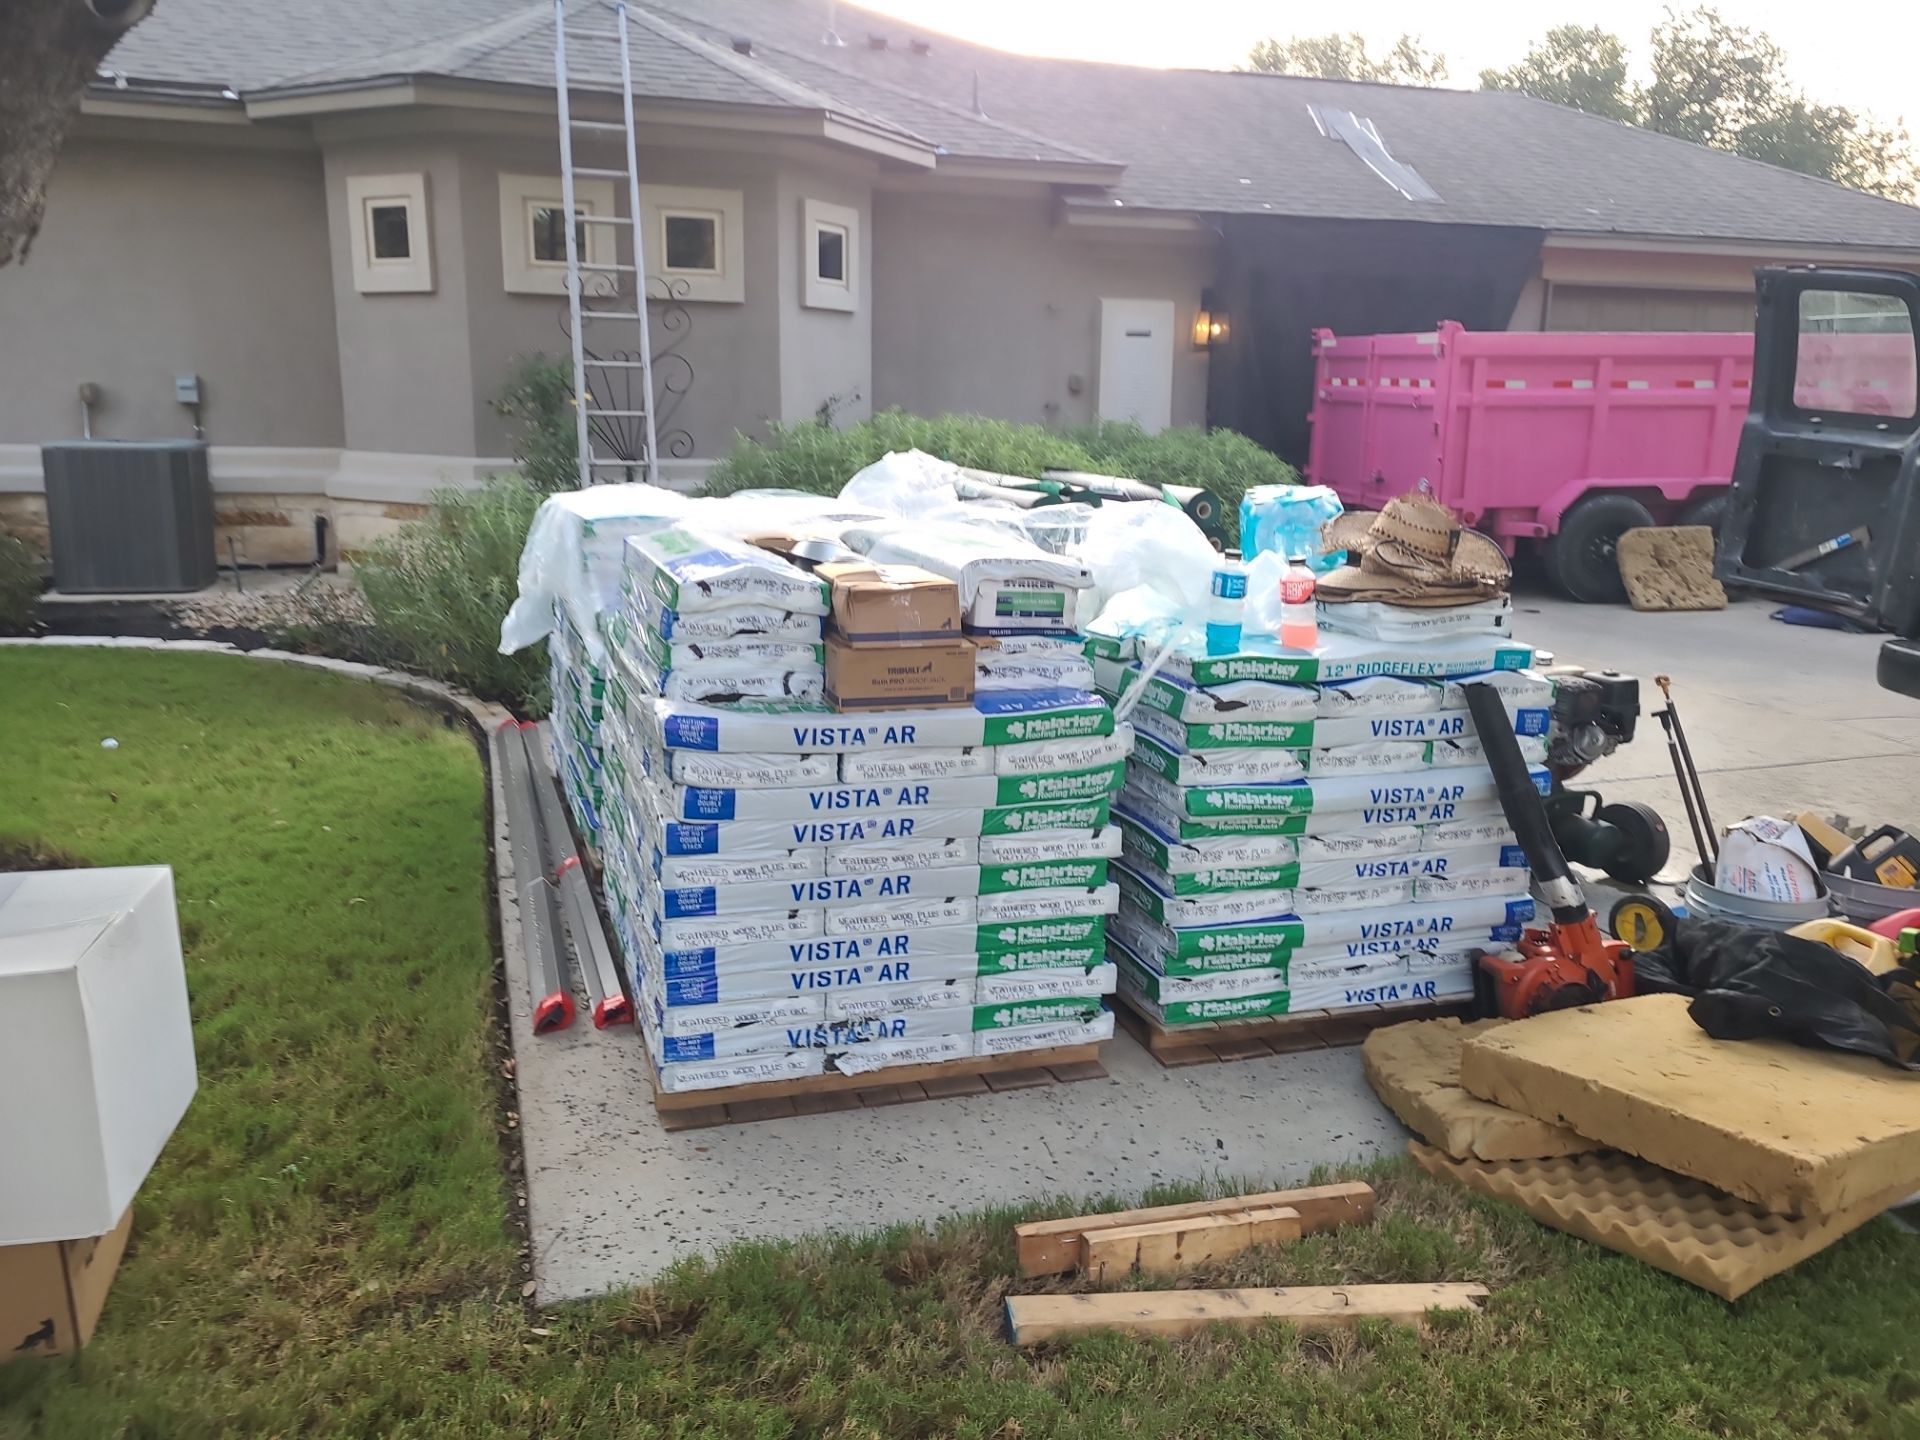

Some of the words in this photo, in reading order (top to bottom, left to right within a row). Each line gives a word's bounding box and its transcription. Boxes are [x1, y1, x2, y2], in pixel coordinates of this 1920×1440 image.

[1229, 661, 1299, 676] Malarkey
[1325, 664, 1352, 678] 12"
[1026, 714, 1103, 730] Malarkey
[1439, 717, 1465, 735] AR
[884, 726, 916, 744] AR
[1226, 723, 1294, 738] Malarkey
[1038, 770, 1114, 790] Malarkey
[897, 786, 930, 805] AR
[1224, 791, 1293, 806] Malarkey
[1438, 786, 1465, 802] AR
[882, 819, 914, 837] AR
[1020, 865, 1097, 879] Malarkey
[1423, 858, 1448, 873] AR
[879, 875, 911, 896] AR
[1018, 922, 1093, 938] Malarkey
[1428, 917, 1454, 933] AR
[878, 935, 909, 956] AR
[878, 962, 910, 981] AR
